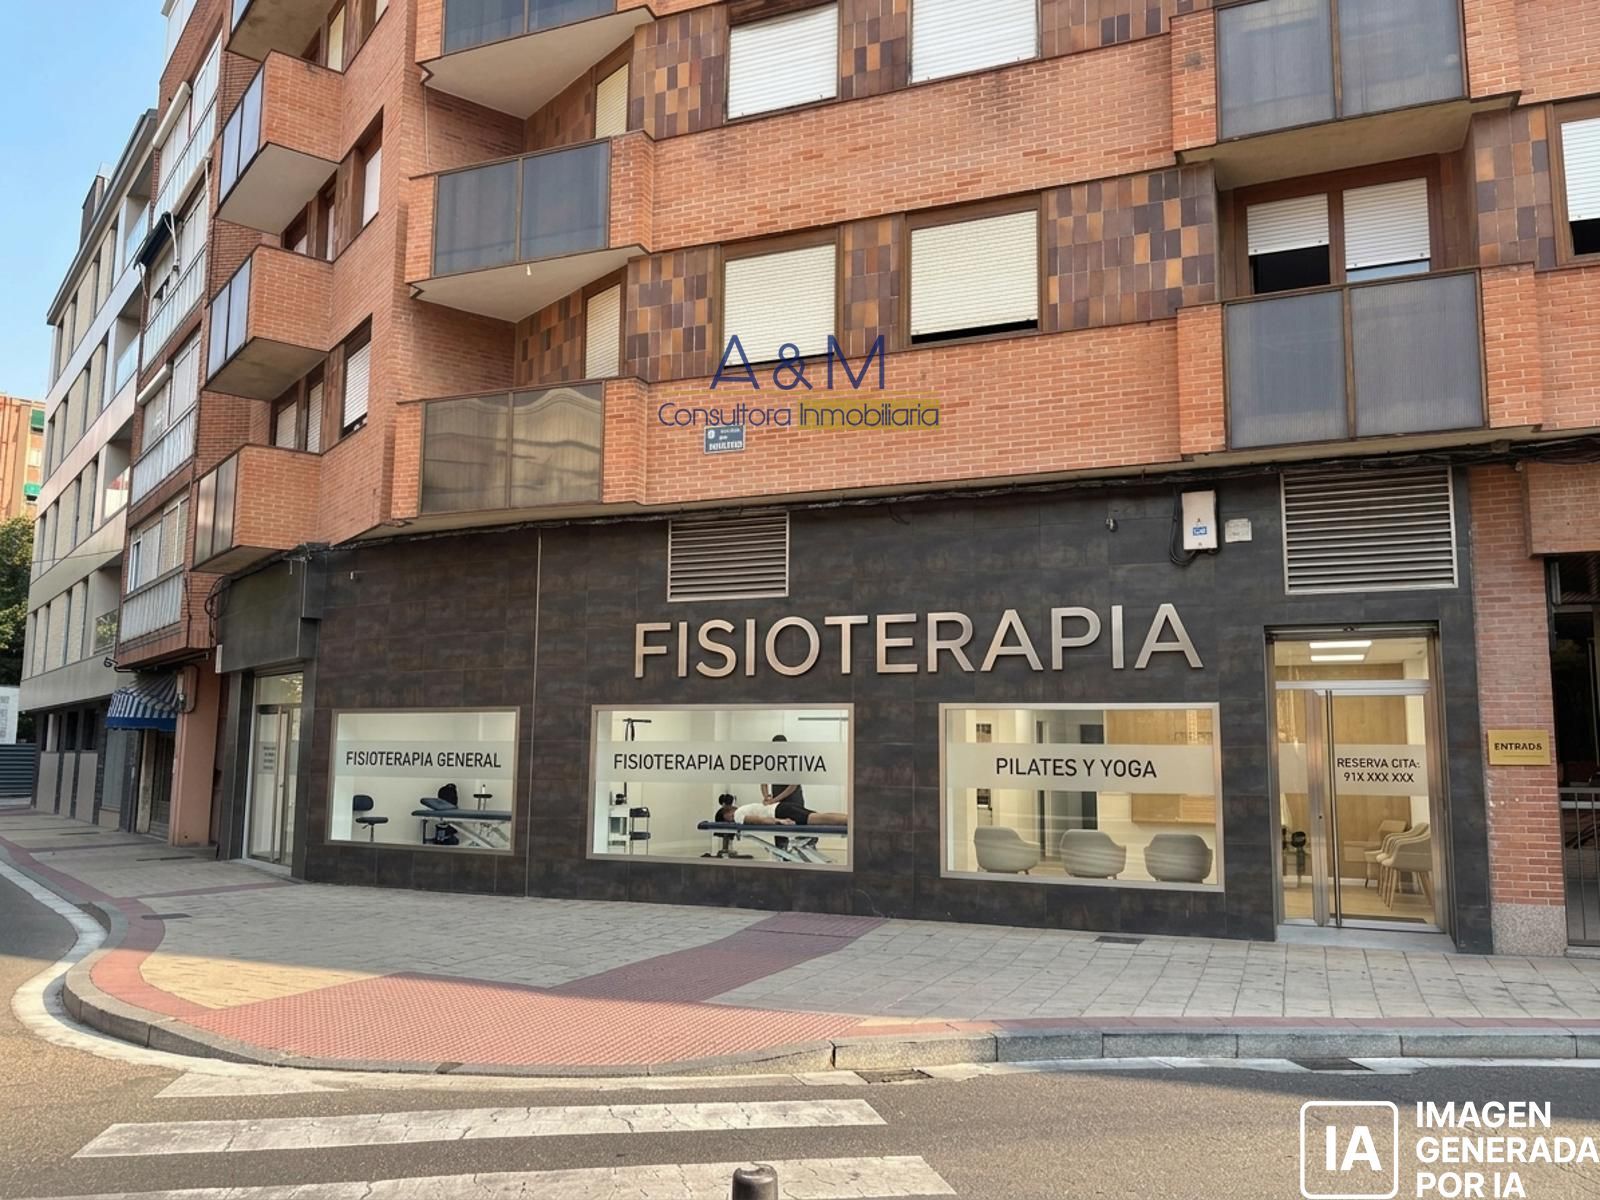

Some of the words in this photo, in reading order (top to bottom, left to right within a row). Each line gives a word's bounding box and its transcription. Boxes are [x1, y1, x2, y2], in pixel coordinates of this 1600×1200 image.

[634, 603, 1204, 678] FISIOTERAPIA
[346, 751, 433, 767] FISIOTERAPIA
[437, 752, 502, 768] GENERAL
[614, 753, 725, 770] FISIOTERAPIA
[730, 754, 827, 772] DEPORTIVA
[996, 757, 1078, 776] PILATES
[1083, 759, 1095, 776] Y
[1100, 759, 1158, 778] YOGA
[1336, 757, 1389, 768] RESERVA
[1343, 772, 1365, 782] 91X
[1367, 772, 1389, 782] XXX
[1391, 773, 1415, 783] XXX
